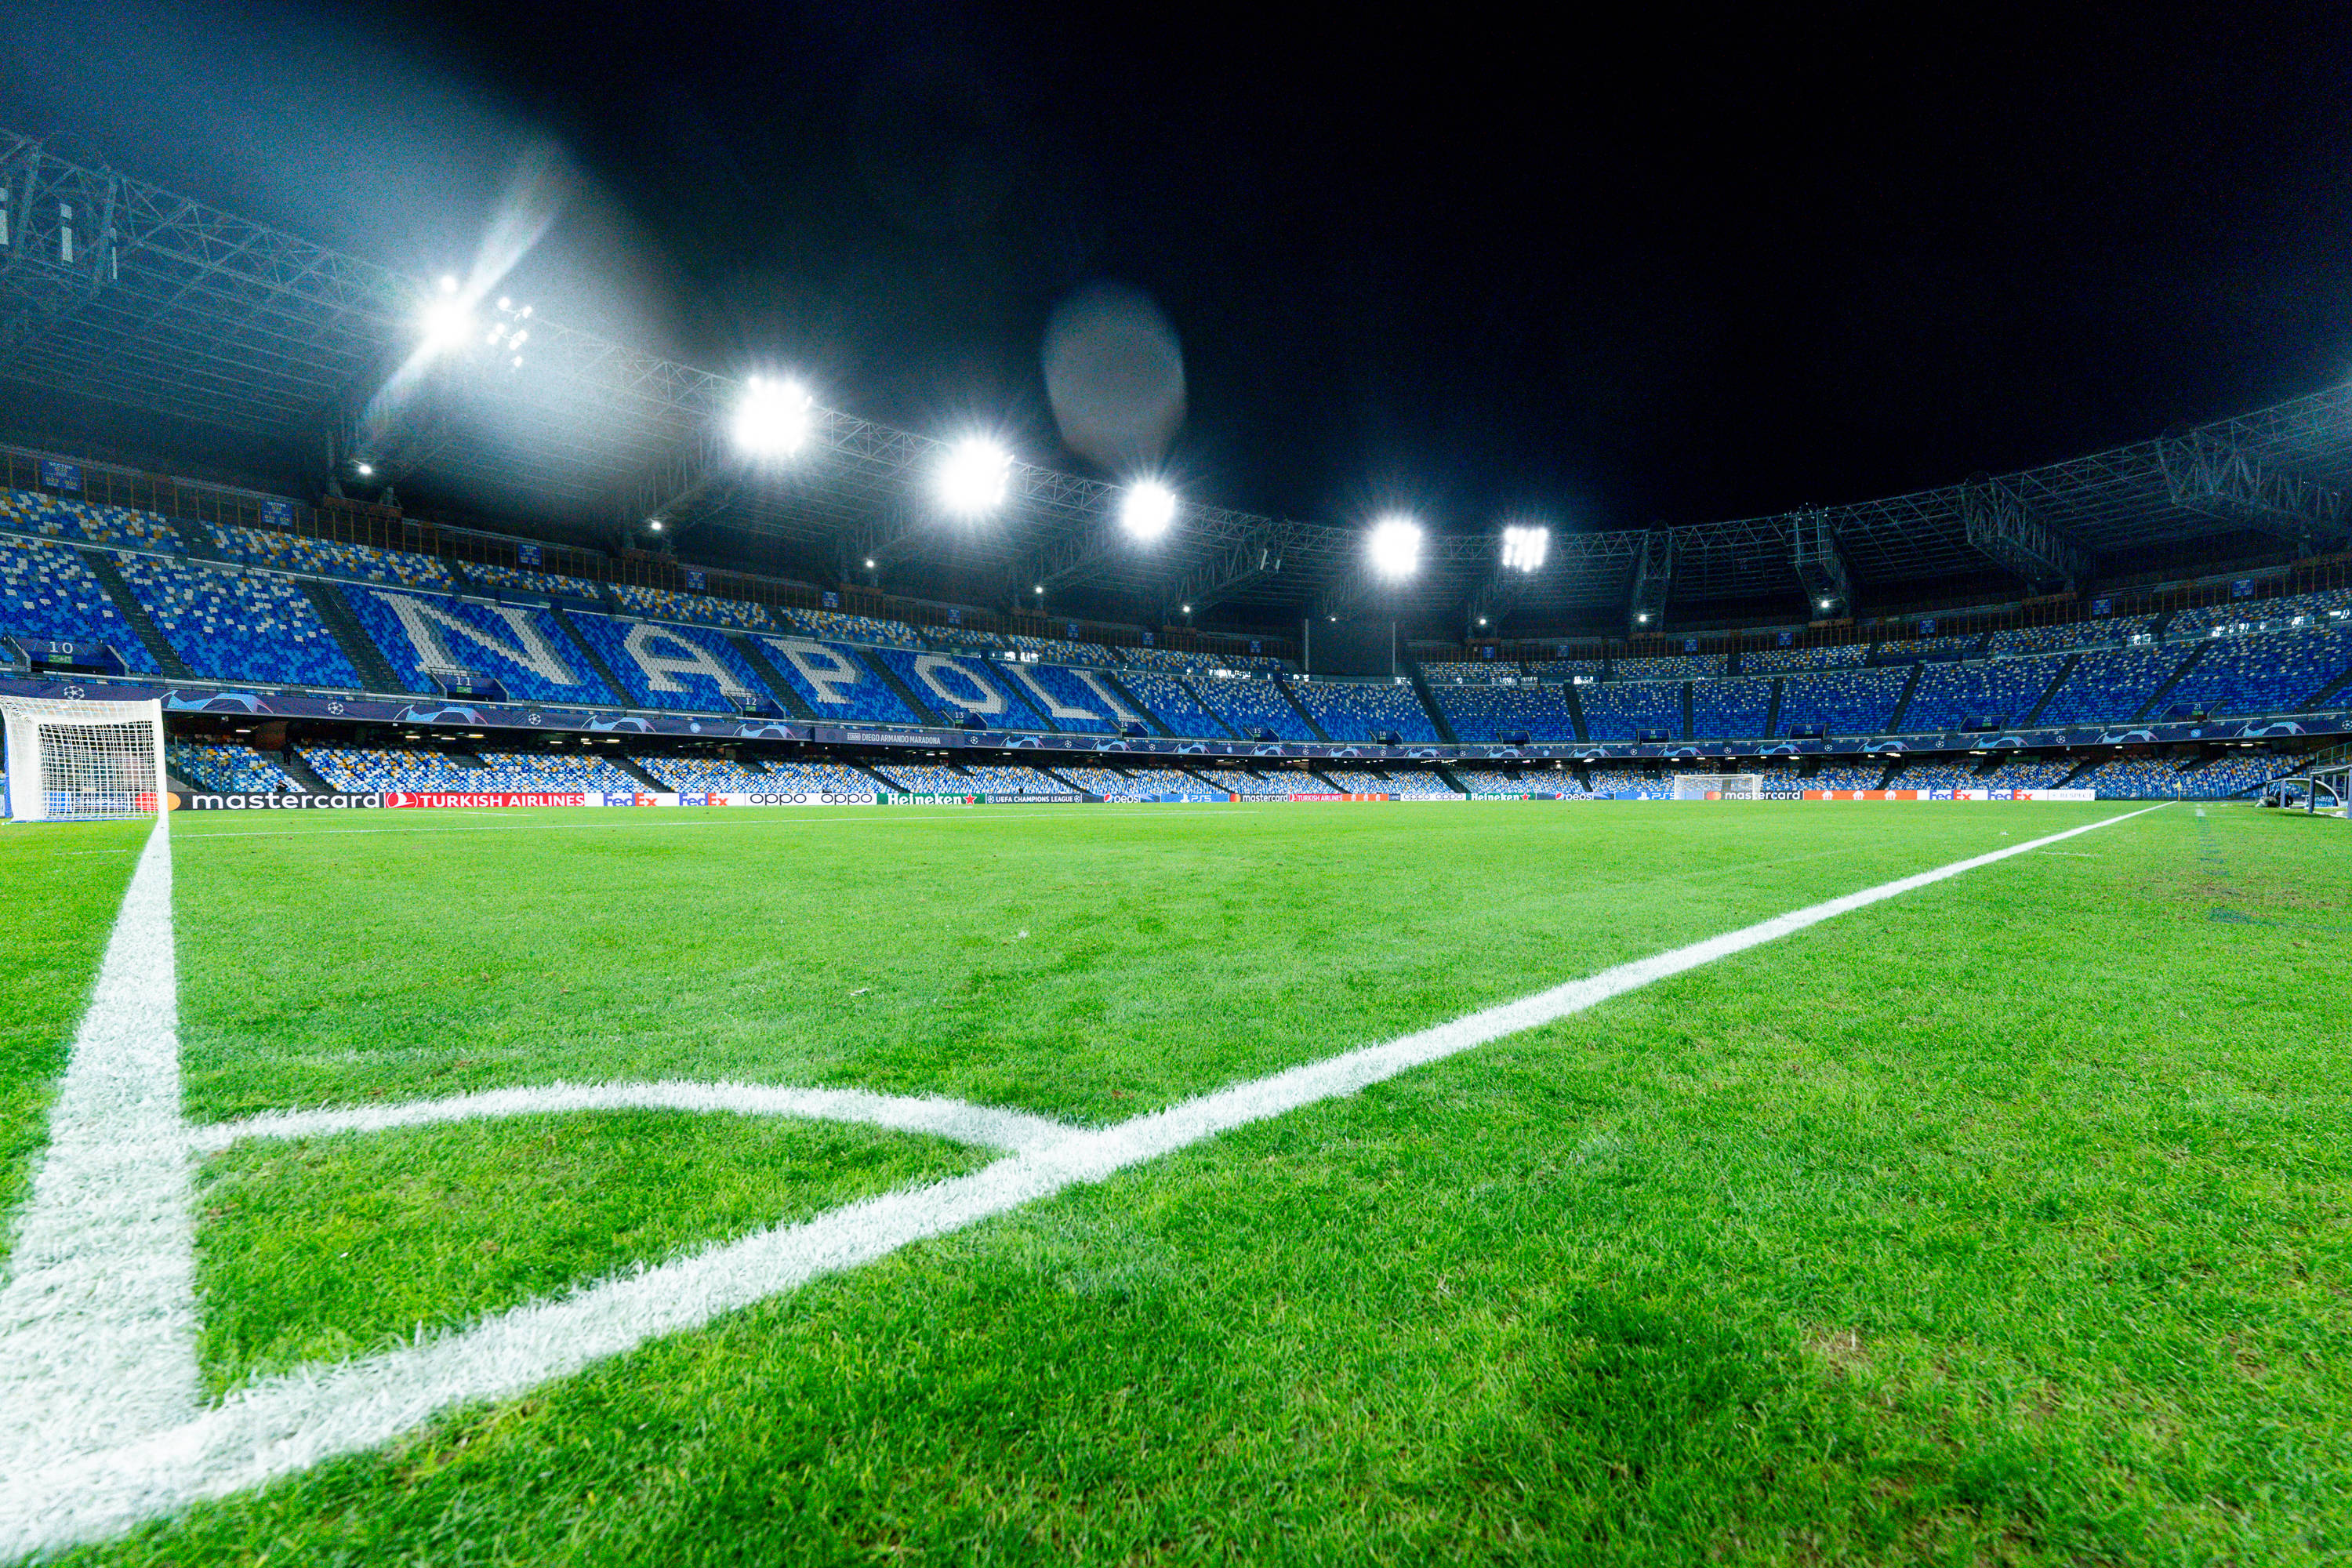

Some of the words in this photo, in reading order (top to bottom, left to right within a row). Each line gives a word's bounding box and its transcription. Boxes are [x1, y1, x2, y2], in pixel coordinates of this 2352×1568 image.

[49, 641, 74, 654] 10
[368, 590, 1145, 723] NAPOLI
[456, 676, 472, 686] 11
[746, 697, 757, 706] 12
[862, 733, 880, 742] DIEGO
[880, 734, 909, 743] ARMANDO
[909, 735, 941, 745] MARADONA
[603, 793, 658, 807] FedEx
[679, 793, 728, 806] FedEx
[750, 793, 807, 806] oppo
[821, 793, 873, 805] oppo
[887, 793, 962, 805] Heineken
[1114, 793, 1141, 803] pepsi
[1242, 793, 1288, 802] mastercard
[1471, 792, 1520, 800] Heineken
[1725, 791, 1801, 800] masercard
[1929, 789, 1972, 800] FedEx
[1988, 789, 2033, 800] FedEx
[192, 792, 379, 810] mastercard
[420, 795, 505, 808] TURKISH
[508, 794, 585, 807] AIRLINES
